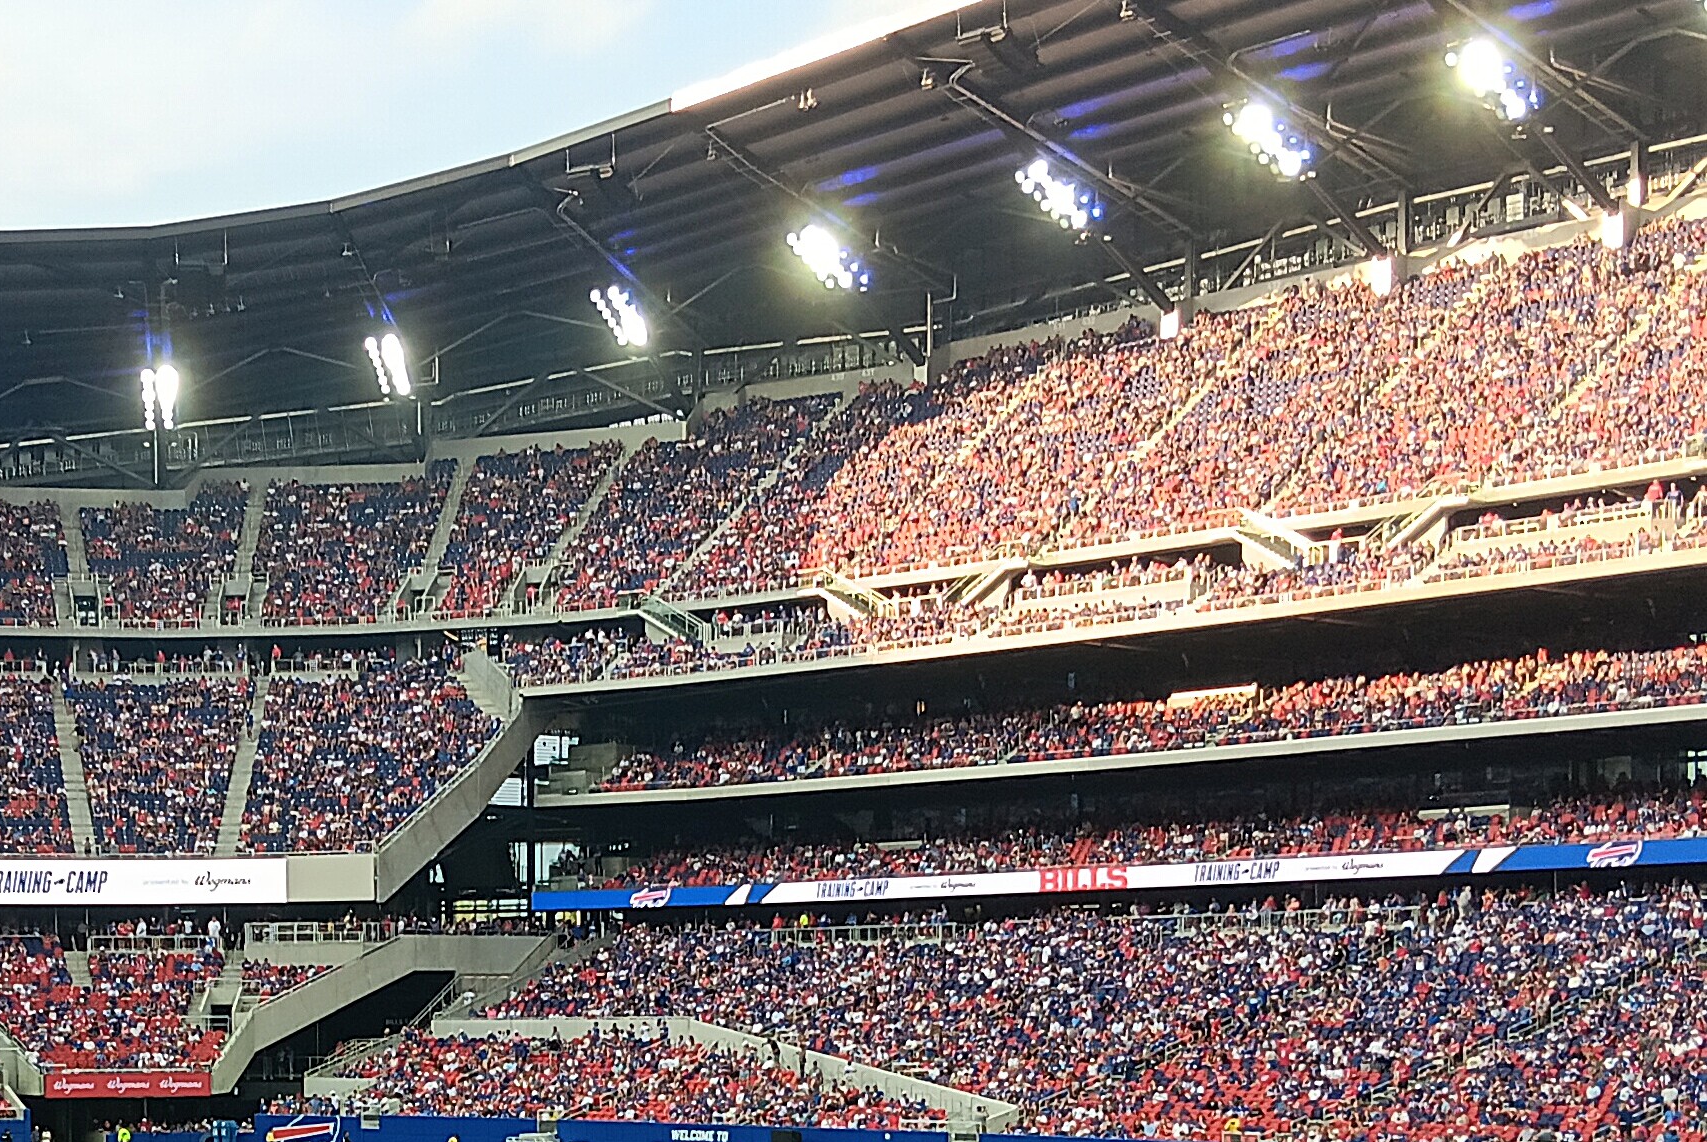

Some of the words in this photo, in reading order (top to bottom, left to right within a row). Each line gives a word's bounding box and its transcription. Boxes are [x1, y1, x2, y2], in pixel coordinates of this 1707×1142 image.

[66, 871, 107, 894] CAMP
[1039, 866, 1128, 893] BILLS
[1194, 861, 1241, 883] TRAINING
[1250, 861, 1280, 880] CAMP
[817, 880, 857, 898] TRAINING
[864, 880, 889, 897] CAMP
[671, 1130, 713, 1142] WELCOME
[717, 1131, 728, 1142] TO
